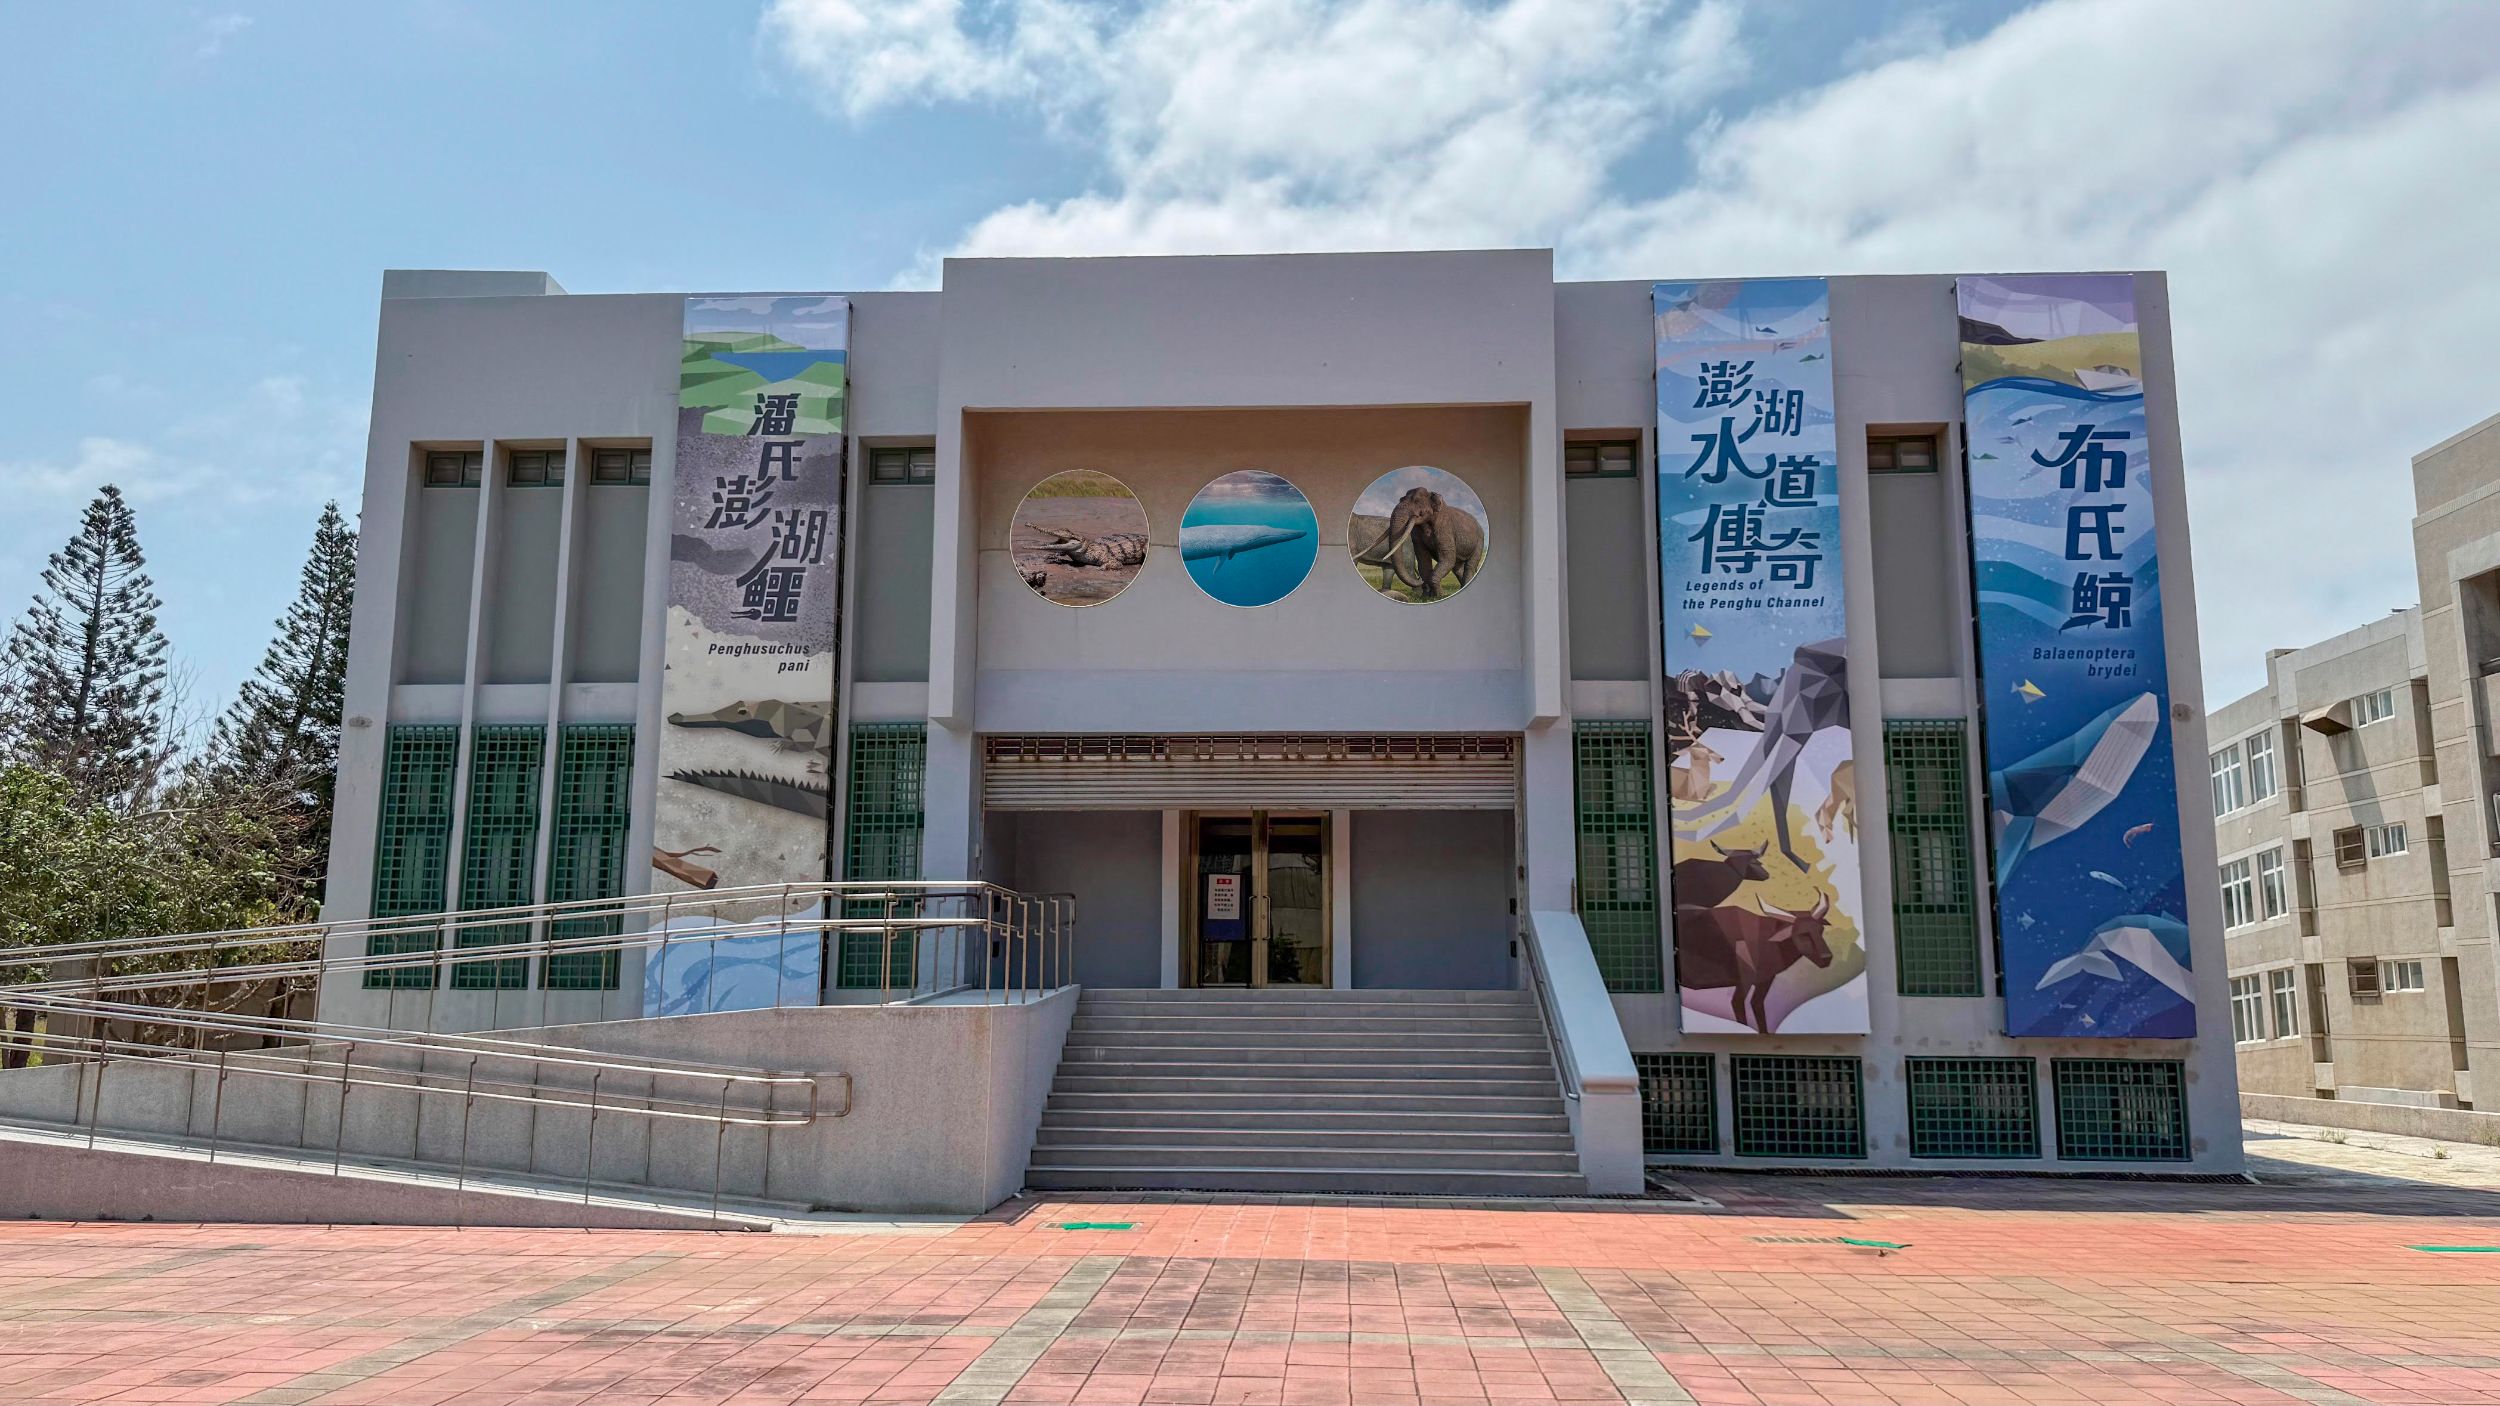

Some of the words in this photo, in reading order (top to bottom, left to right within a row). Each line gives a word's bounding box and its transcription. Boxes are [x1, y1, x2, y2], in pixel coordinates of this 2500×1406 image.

[1693, 360, 1804, 444] 澎湖
[1685, 416, 1821, 508] 水道
[704, 393, 828, 623] 潘氏澎湖鱷
[2031, 424, 2134, 631] 布氏鯨
[1687, 501, 1823, 590] 傳奇
[1687, 579, 1744, 592] Legends
[1750, 578, 1764, 590] of
[1683, 599, 1705, 610] the
[1710, 597, 1762, 610] Penghu
[1767, 596, 1825, 608] Channel
[708, 643, 810, 657] Penghusuchus
[2033, 647, 2136, 661] Balaenoptera
[778, 659, 810, 673] pani
[2087, 664, 2137, 678] brydei
